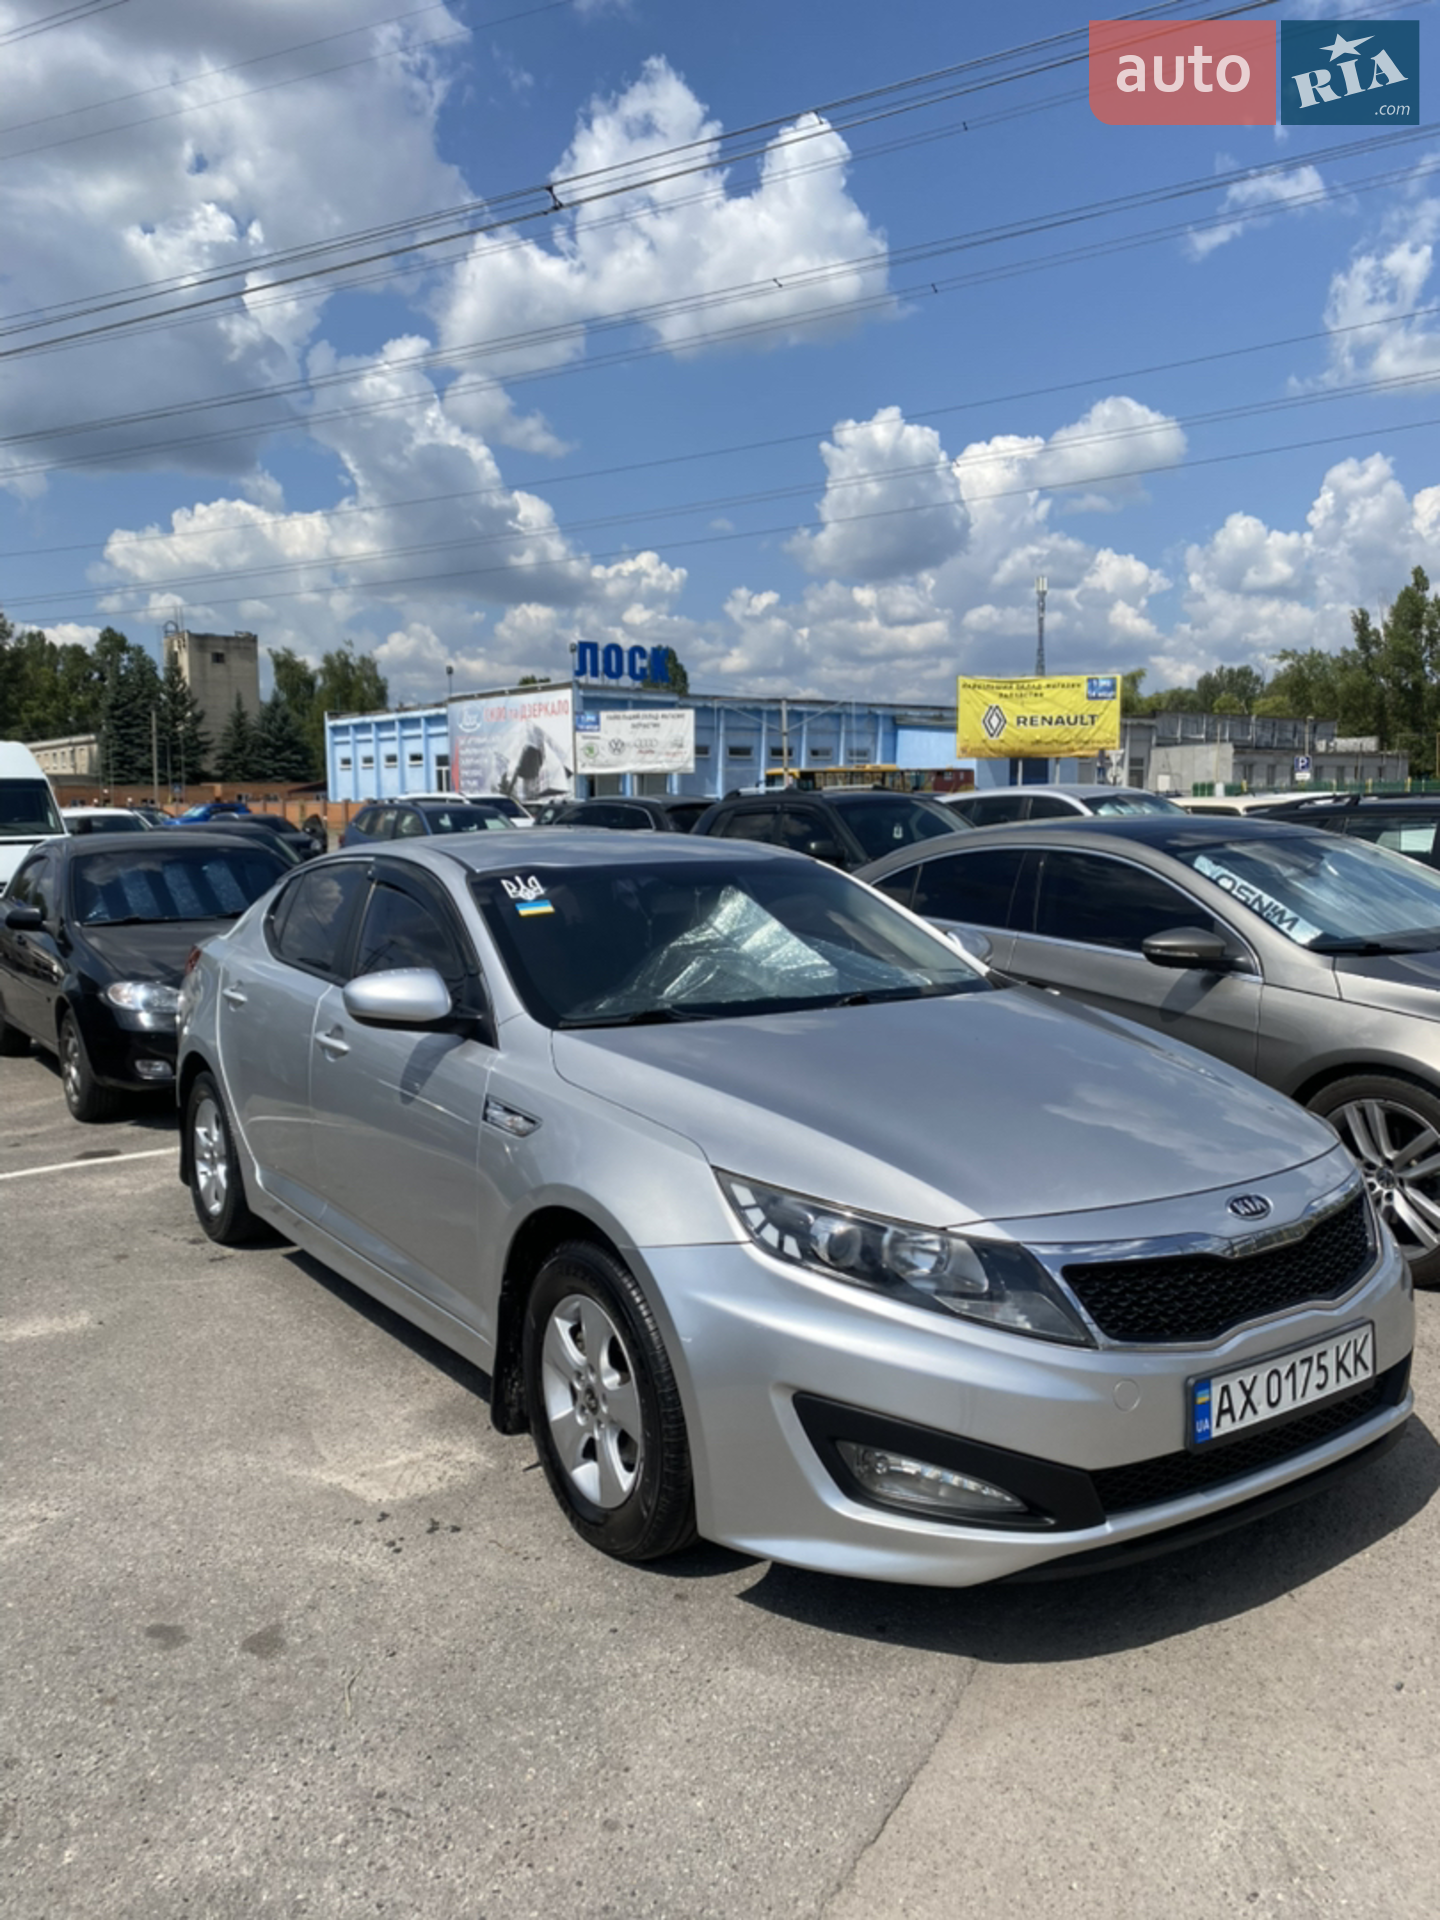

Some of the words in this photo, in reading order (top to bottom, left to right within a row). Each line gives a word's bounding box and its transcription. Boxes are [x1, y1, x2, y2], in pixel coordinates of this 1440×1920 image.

[574, 640, 672, 684] ЛОСК
[519, 699, 570, 722] ДЗЕРКАЛО
[1016, 714, 1099, 727] RENAULT
[1298, 756, 1309, 771] P
[1232, 1198, 1268, 1215] KIA
[1215, 1374, 1259, 1429] AX
[1266, 1350, 1329, 1409] 0175
[1336, 1333, 1370, 1384] KK
[1195, 1418, 1211, 1433] UA
